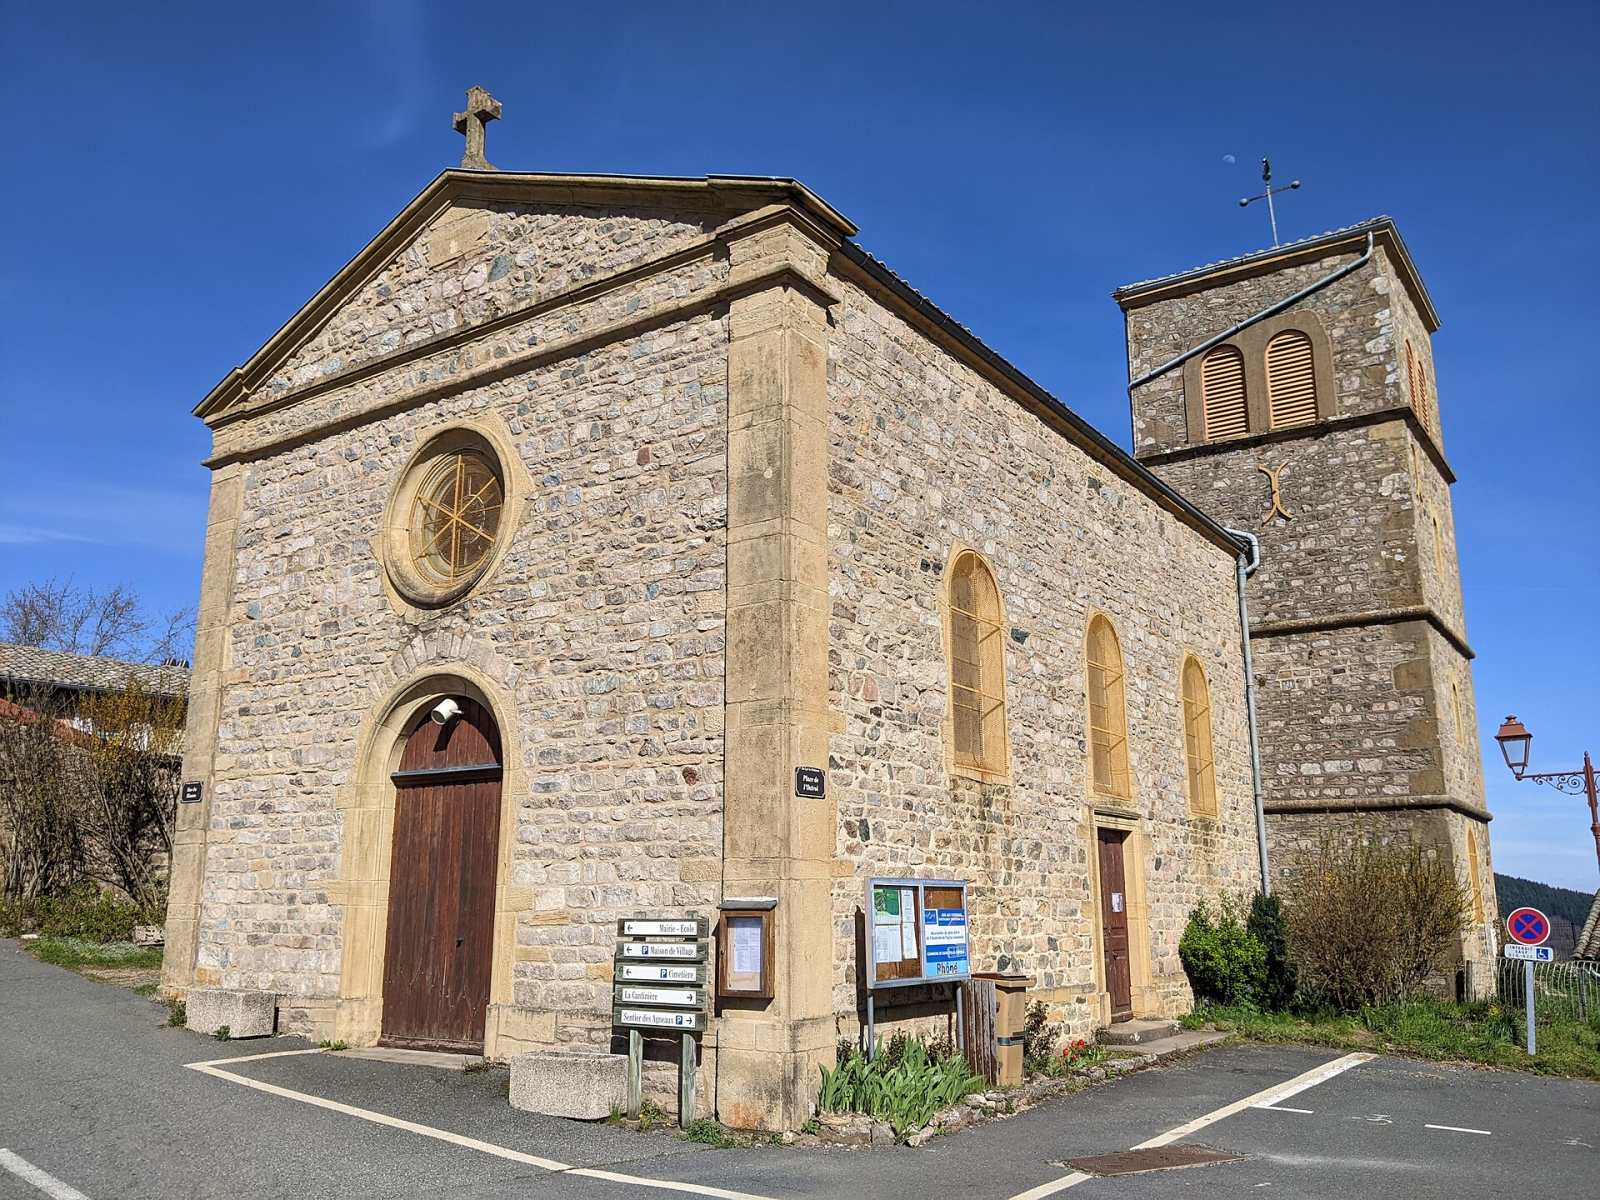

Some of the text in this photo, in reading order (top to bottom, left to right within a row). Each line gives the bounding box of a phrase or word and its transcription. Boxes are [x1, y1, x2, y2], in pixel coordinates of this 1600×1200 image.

[660, 924, 675, 932] Mairie
[651, 946, 668, 955] Maison
[669, 947, 675, 955] de
[677, 947, 694, 956] Village
[668, 970, 694, 978] Cimetière
[624, 991, 630, 999] La
[623, 1013, 641, 1021] Sentier
